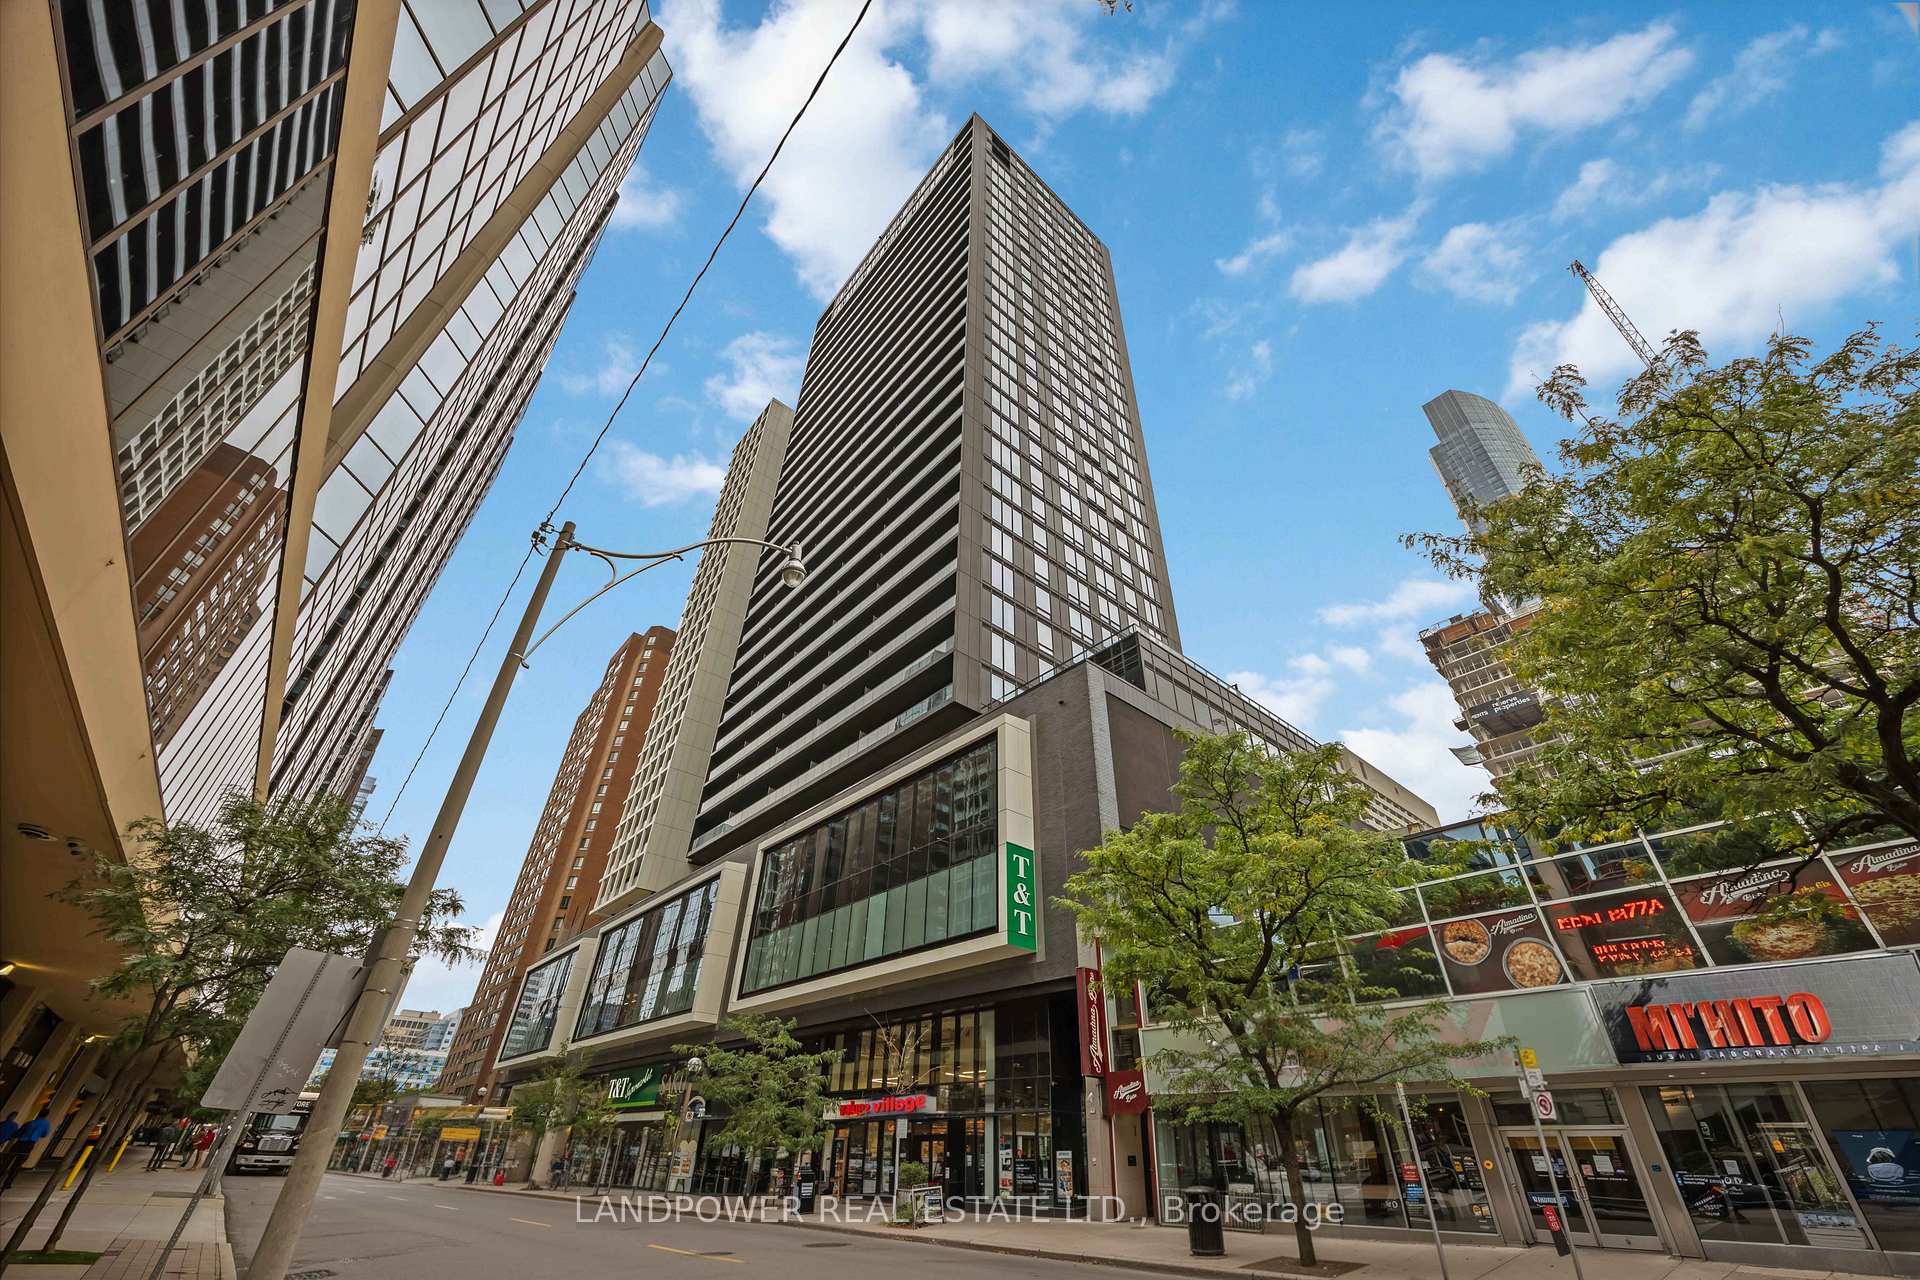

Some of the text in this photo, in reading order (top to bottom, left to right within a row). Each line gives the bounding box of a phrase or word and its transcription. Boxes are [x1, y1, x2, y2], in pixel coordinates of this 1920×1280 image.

[1851, 845, 1920, 874] Almadina
[1013, 853, 1032, 936] T&T
[1490, 912, 1538, 936] Almadina
[1625, 992, 1832, 1051] MI'HITO
[1645, 1052, 1696, 1061] SUSHI
[607, 1077, 630, 1099] T&T
[873, 1094, 928, 1113] village
